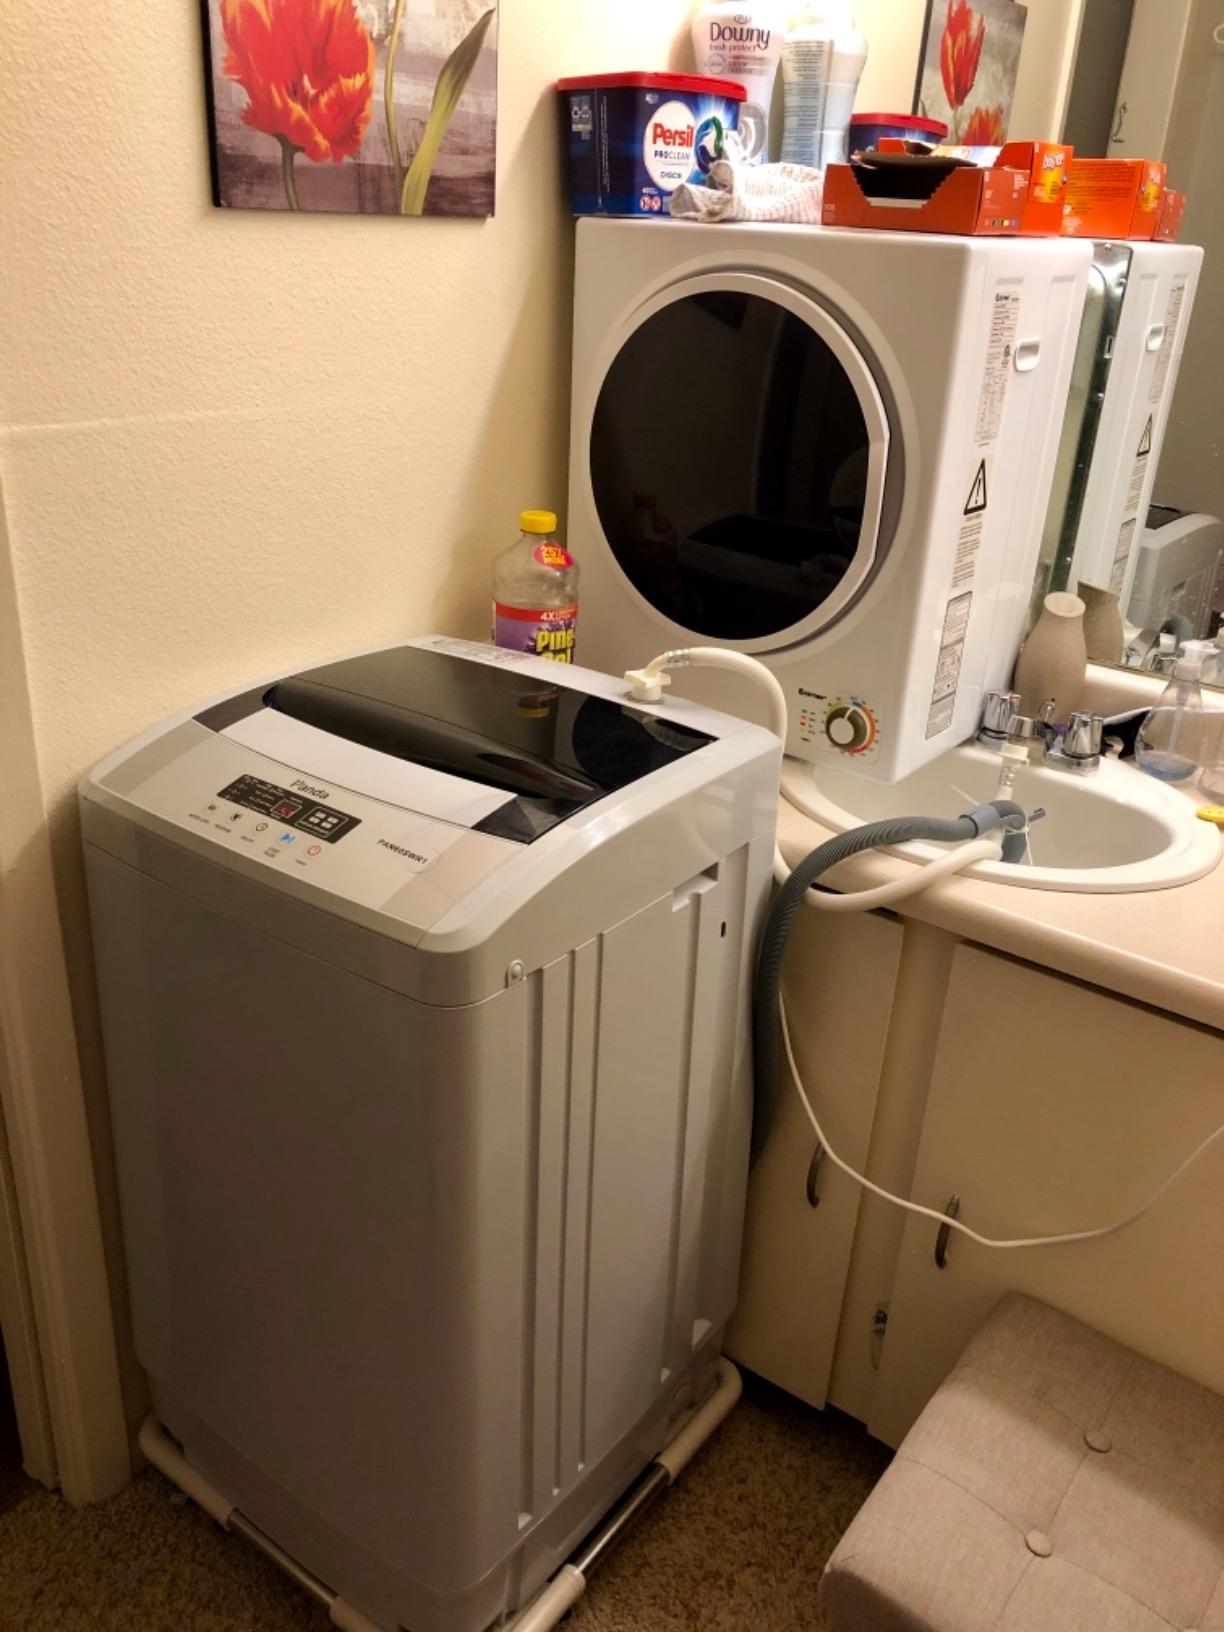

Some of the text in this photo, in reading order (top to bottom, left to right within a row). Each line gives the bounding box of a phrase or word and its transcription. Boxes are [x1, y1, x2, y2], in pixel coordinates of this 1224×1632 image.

[710, 22, 771, 51] Downy
[652, 122, 694, 147] Persil
[654, 150, 690, 160] PROCLEAN
[290, 779, 330, 800] Panda
